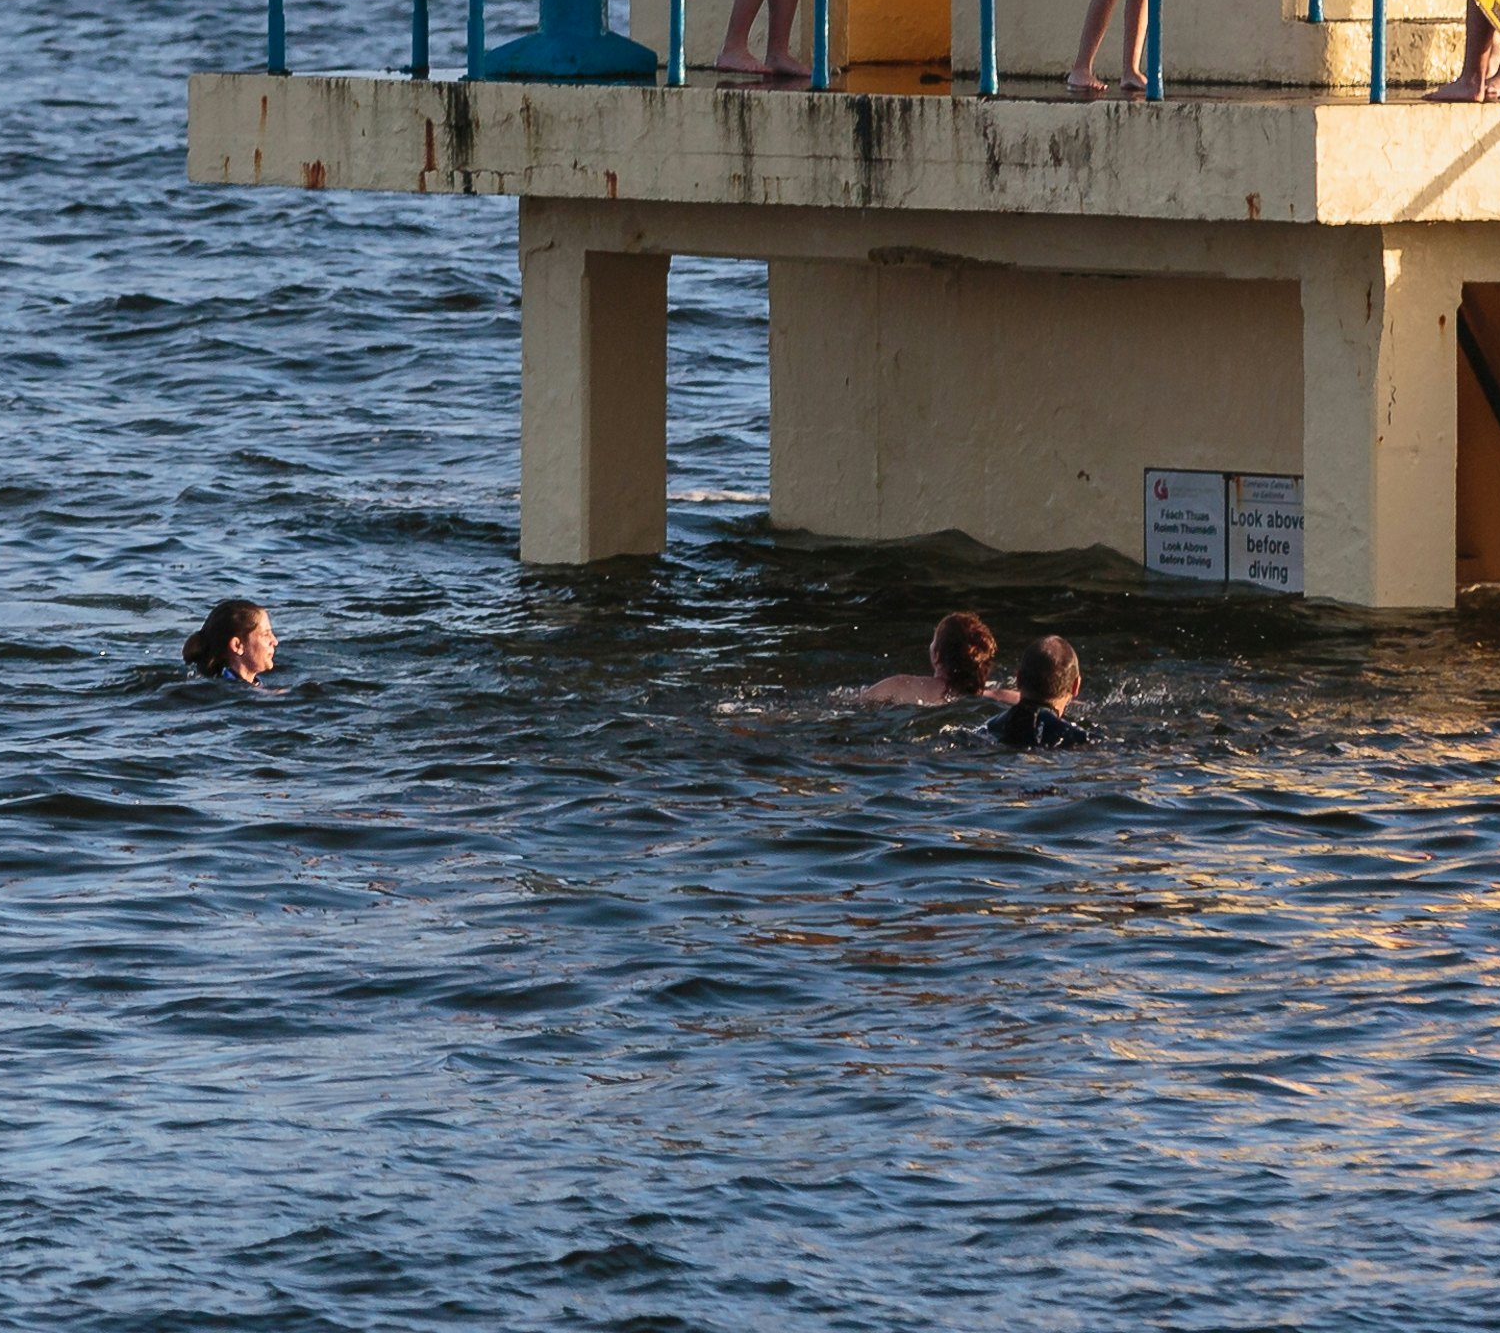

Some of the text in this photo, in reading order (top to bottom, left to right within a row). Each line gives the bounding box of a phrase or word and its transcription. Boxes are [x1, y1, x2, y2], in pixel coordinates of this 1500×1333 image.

[1186, 509, 1210, 522] Thuas
[1230, 507, 1304, 530] Look above
[1162, 541, 1208, 553] Look Above
[1246, 534, 1290, 555] before
[1159, 554, 1212, 569] Before Diving
[1248, 560, 1288, 584] diving
